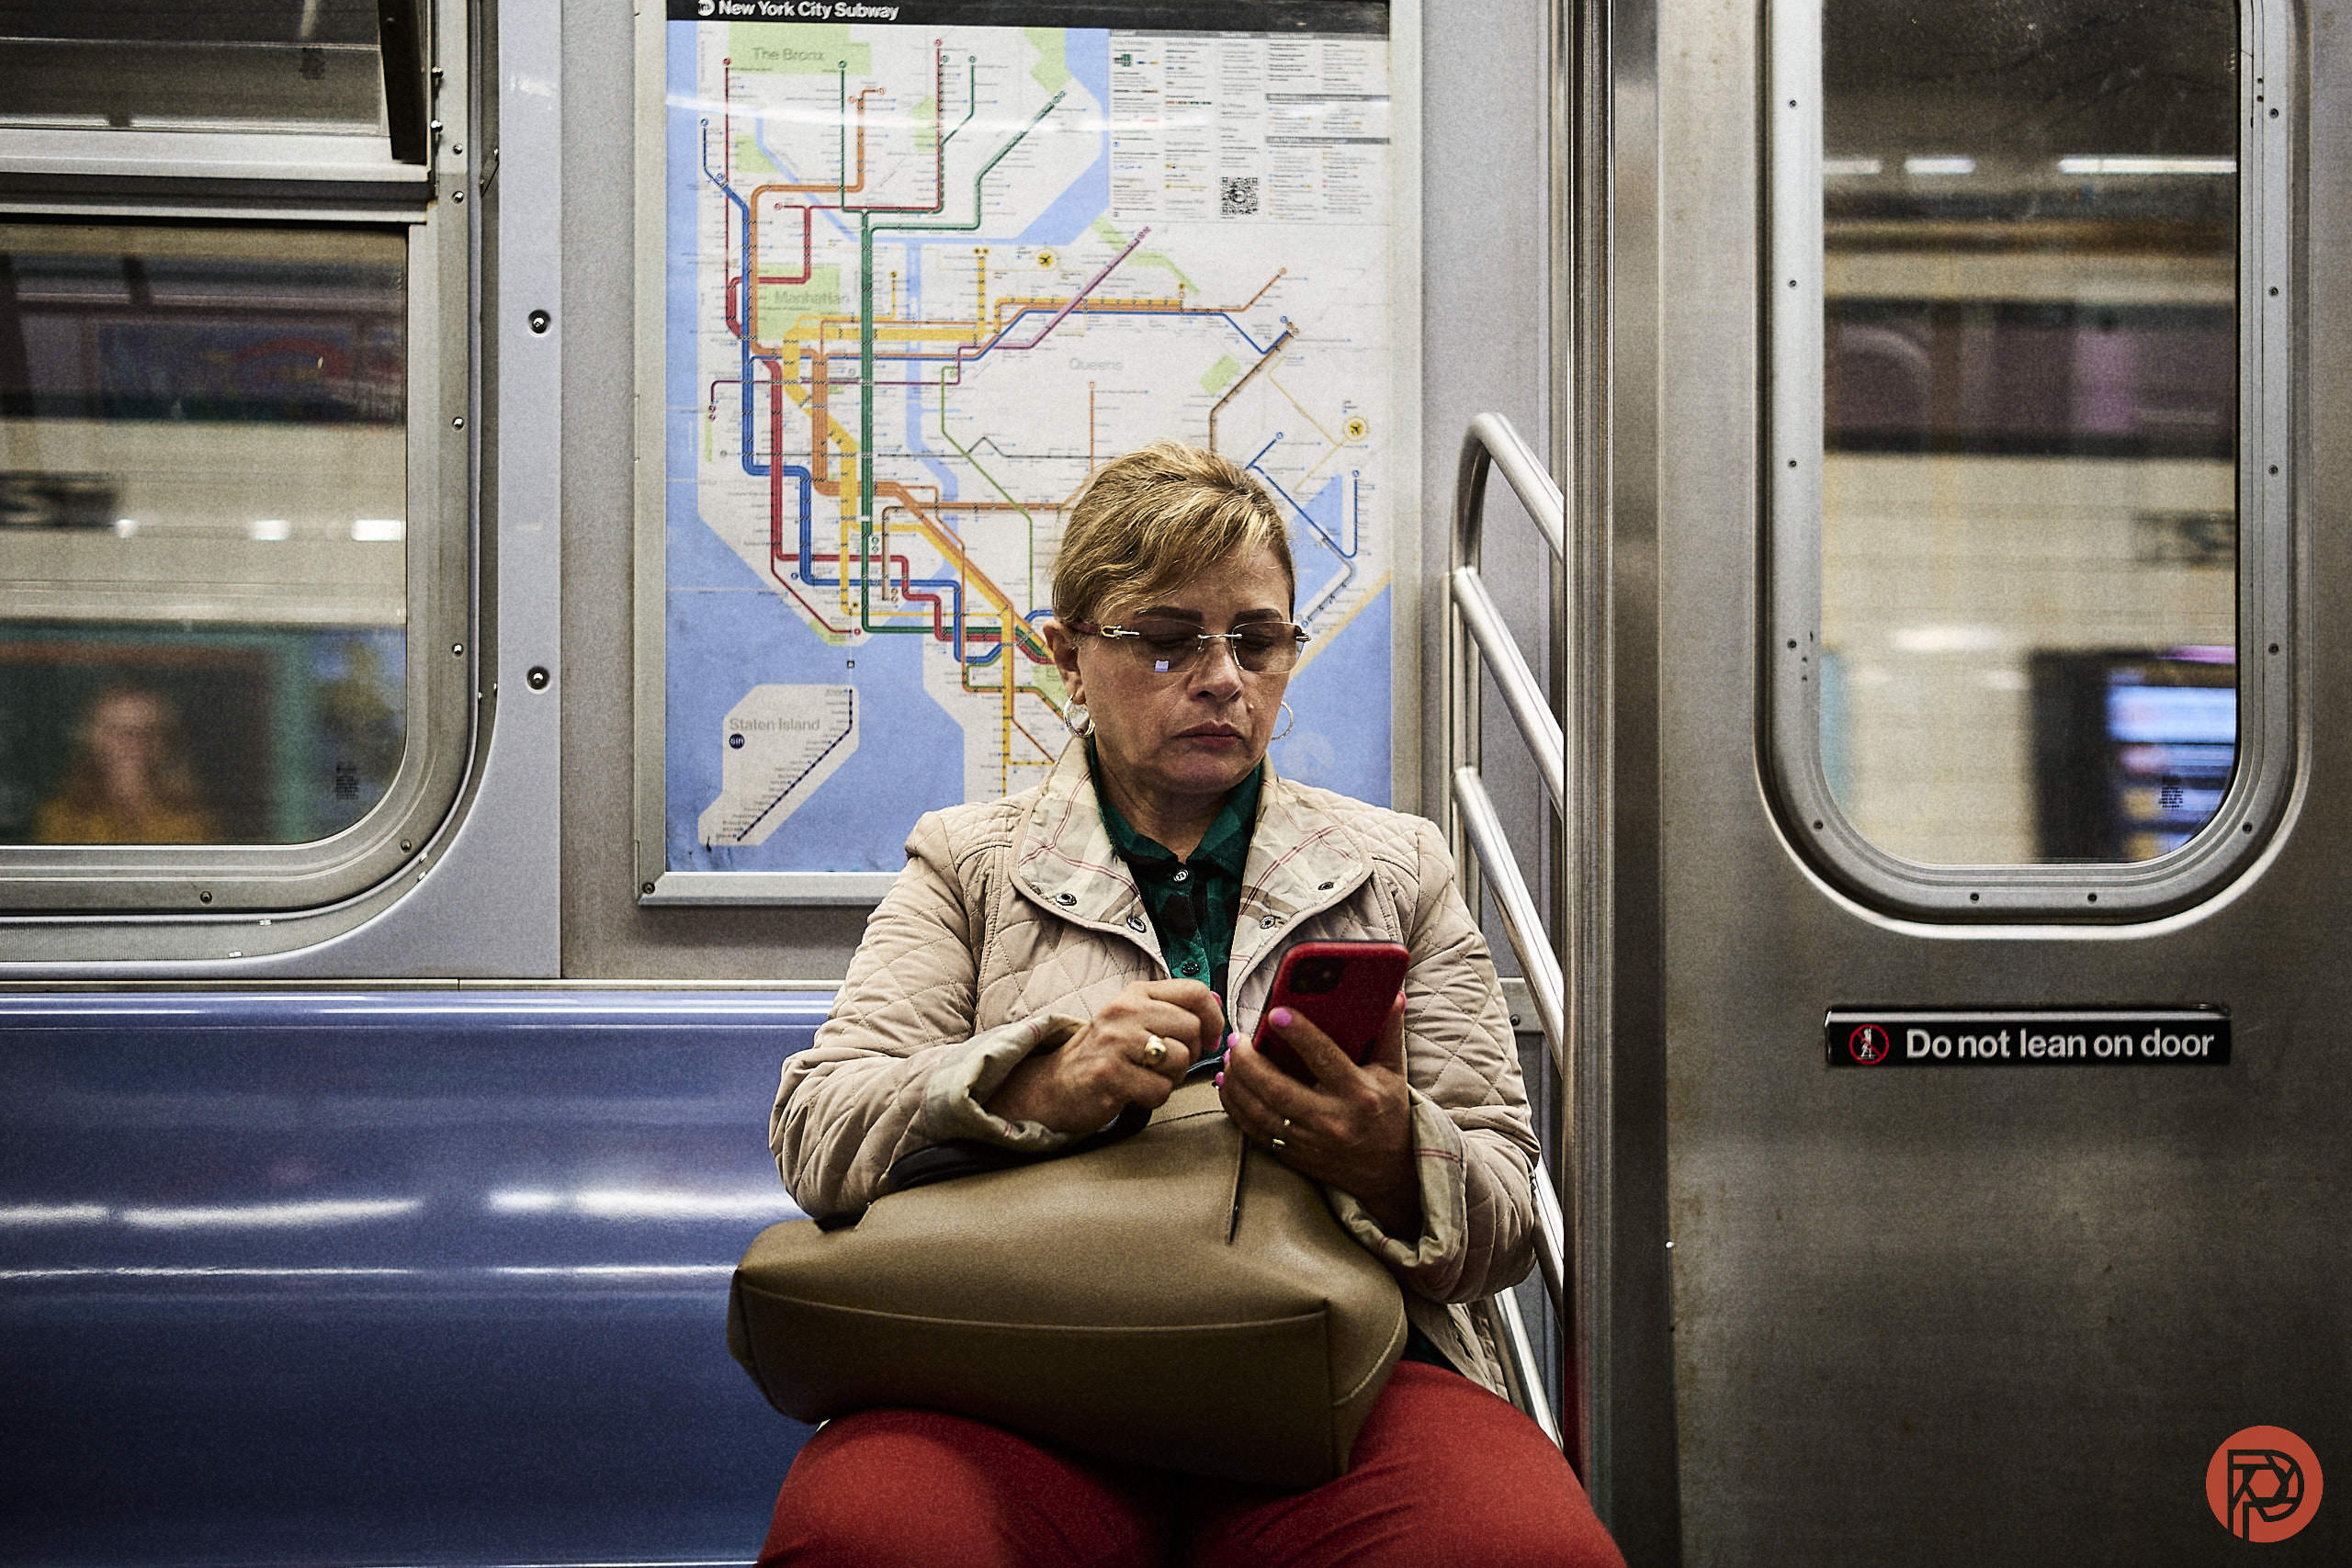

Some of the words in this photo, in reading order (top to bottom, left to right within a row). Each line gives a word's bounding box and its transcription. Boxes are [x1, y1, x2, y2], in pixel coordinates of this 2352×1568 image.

[718, 0, 755, 16] New
[758, 0, 796, 17] York
[797, 1, 833, 19] City
[834, 3, 899, 20] Subway
[752, 47, 779, 61] The
[783, 48, 824, 61] Bronx
[1069, 357, 1123, 371] Queens
[729, 717, 775, 730] Staten
[778, 717, 820, 730] Island
[1906, 1029, 1951, 1057] Do
[1958, 1030, 2011, 1057] not
[2019, 1029, 2086, 1057] lean
[2094, 1034, 2133, 1057] on
[2141, 1028, 2214, 1057] door
